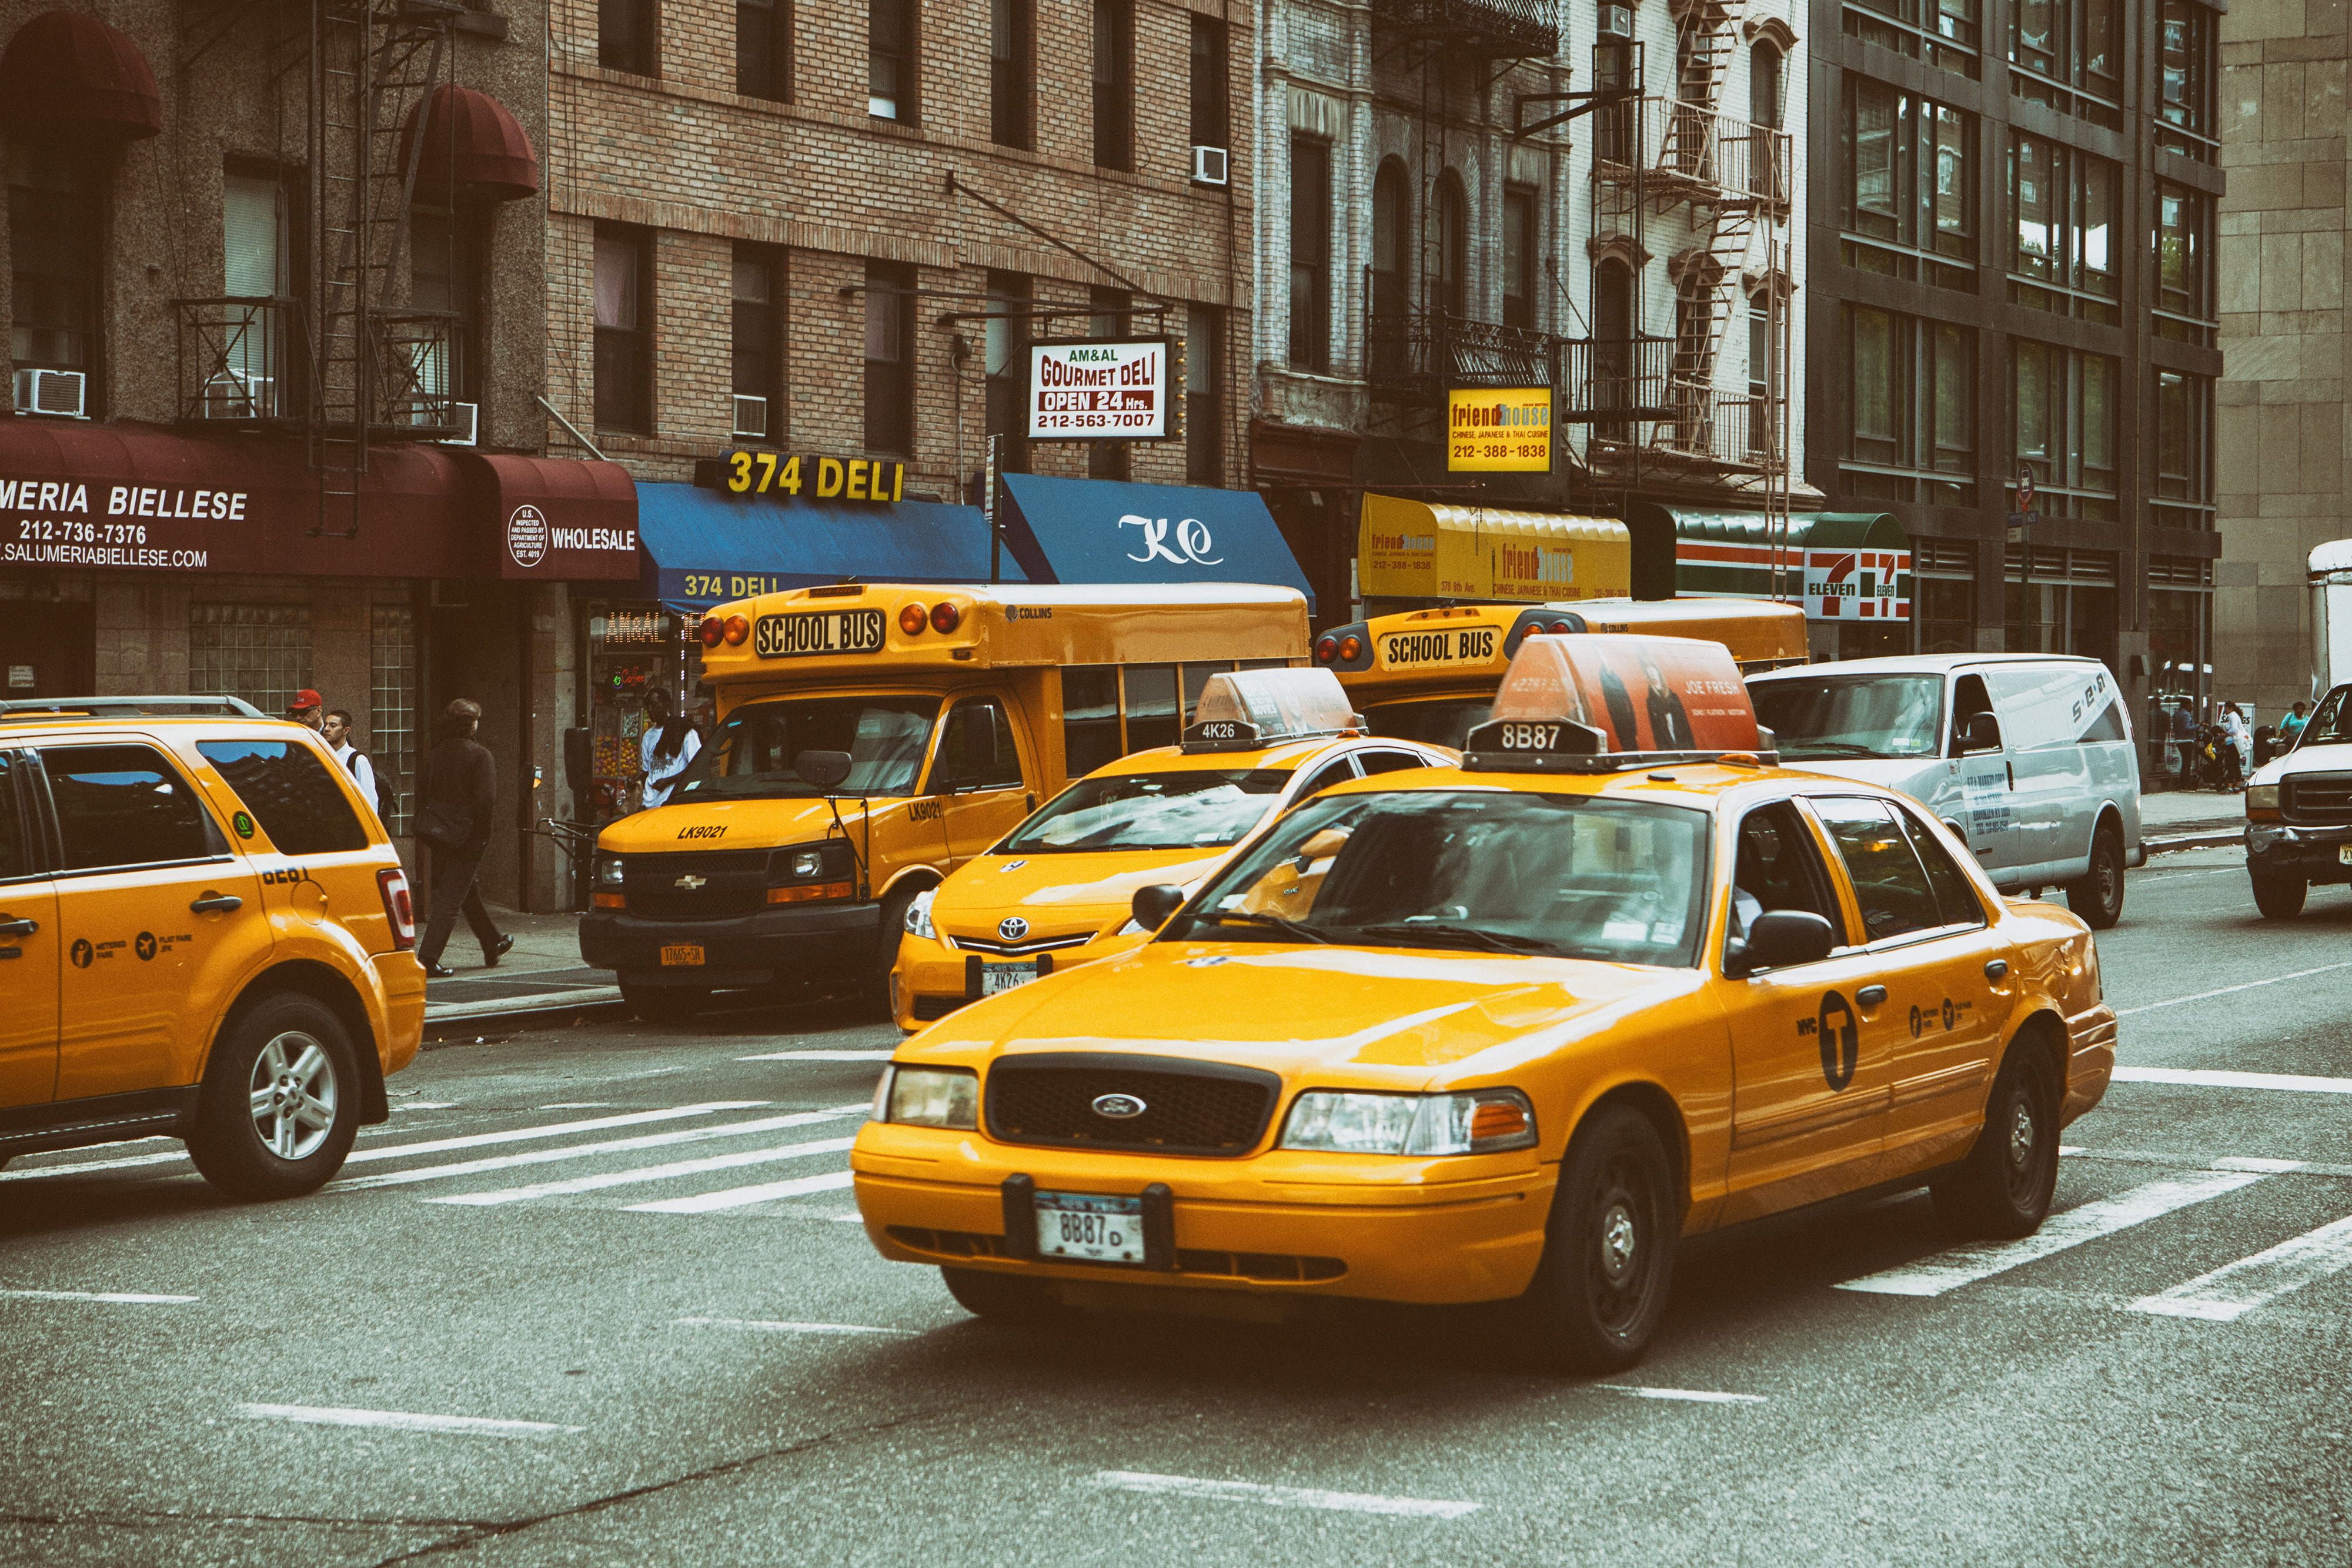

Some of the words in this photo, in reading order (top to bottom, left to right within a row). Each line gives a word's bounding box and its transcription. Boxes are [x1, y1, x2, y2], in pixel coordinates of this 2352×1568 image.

[1068, 349, 1118, 362] AM&AL
[1041, 355, 1115, 386] GOURMET
[1121, 352, 1155, 386] DELI
[1044, 392, 1090, 411] OPEN
[1097, 392, 1123, 410] 24
[1126, 397, 1147, 410] Hrs.
[1038, 414, 1154, 427] 212-563-7007
[1452, 431, 1476, 439] CHINESE,
[1478, 430, 1504, 439] JAPANESE
[1454, 445, 1546, 457] 212-388-1838
[728, 451, 802, 496] 374
[816, 457, 904, 503] DELI
[0, 480, 88, 513] MERIA
[108, 486, 247, 520] BIELLESE
[522, 510, 533, 518] U.S.
[20, 520, 146, 544] 212-736-7376
[552, 527, 635, 551] WHOLESALE
[0, 543, 207, 567] .SALUMERIABIELLESE.COM
[1374, 561, 1431, 570] 212-388-1838
[685, 575, 723, 597] 374
[1441, 581, 1451, 591] 370
[1517, 586, 1542, 596] JAPANESE
[1549, 587, 1561, 596] THAI
[1562, 587, 1581, 597] CUISINE
[1810, 553, 1855, 616] 7
[1020, 607, 1052, 618] COLLINS
[606, 612, 666, 642] AM&AL
[759, 616, 834, 653] SCHOOL
[840, 613, 878, 649] BUS
[1388, 634, 1452, 663] SCHOOL
[1459, 631, 1493, 658] BUS
[1685, 681, 1705, 694] JOE
[1705, 681, 1740, 694] FRESH
[1202, 723, 1235, 738] 4K26
[1502, 724, 1560, 749] 8B87
[908, 801, 941, 821] LK9021
[677, 825, 728, 840] LK9021
[995, 973, 1019, 989] 4K26
